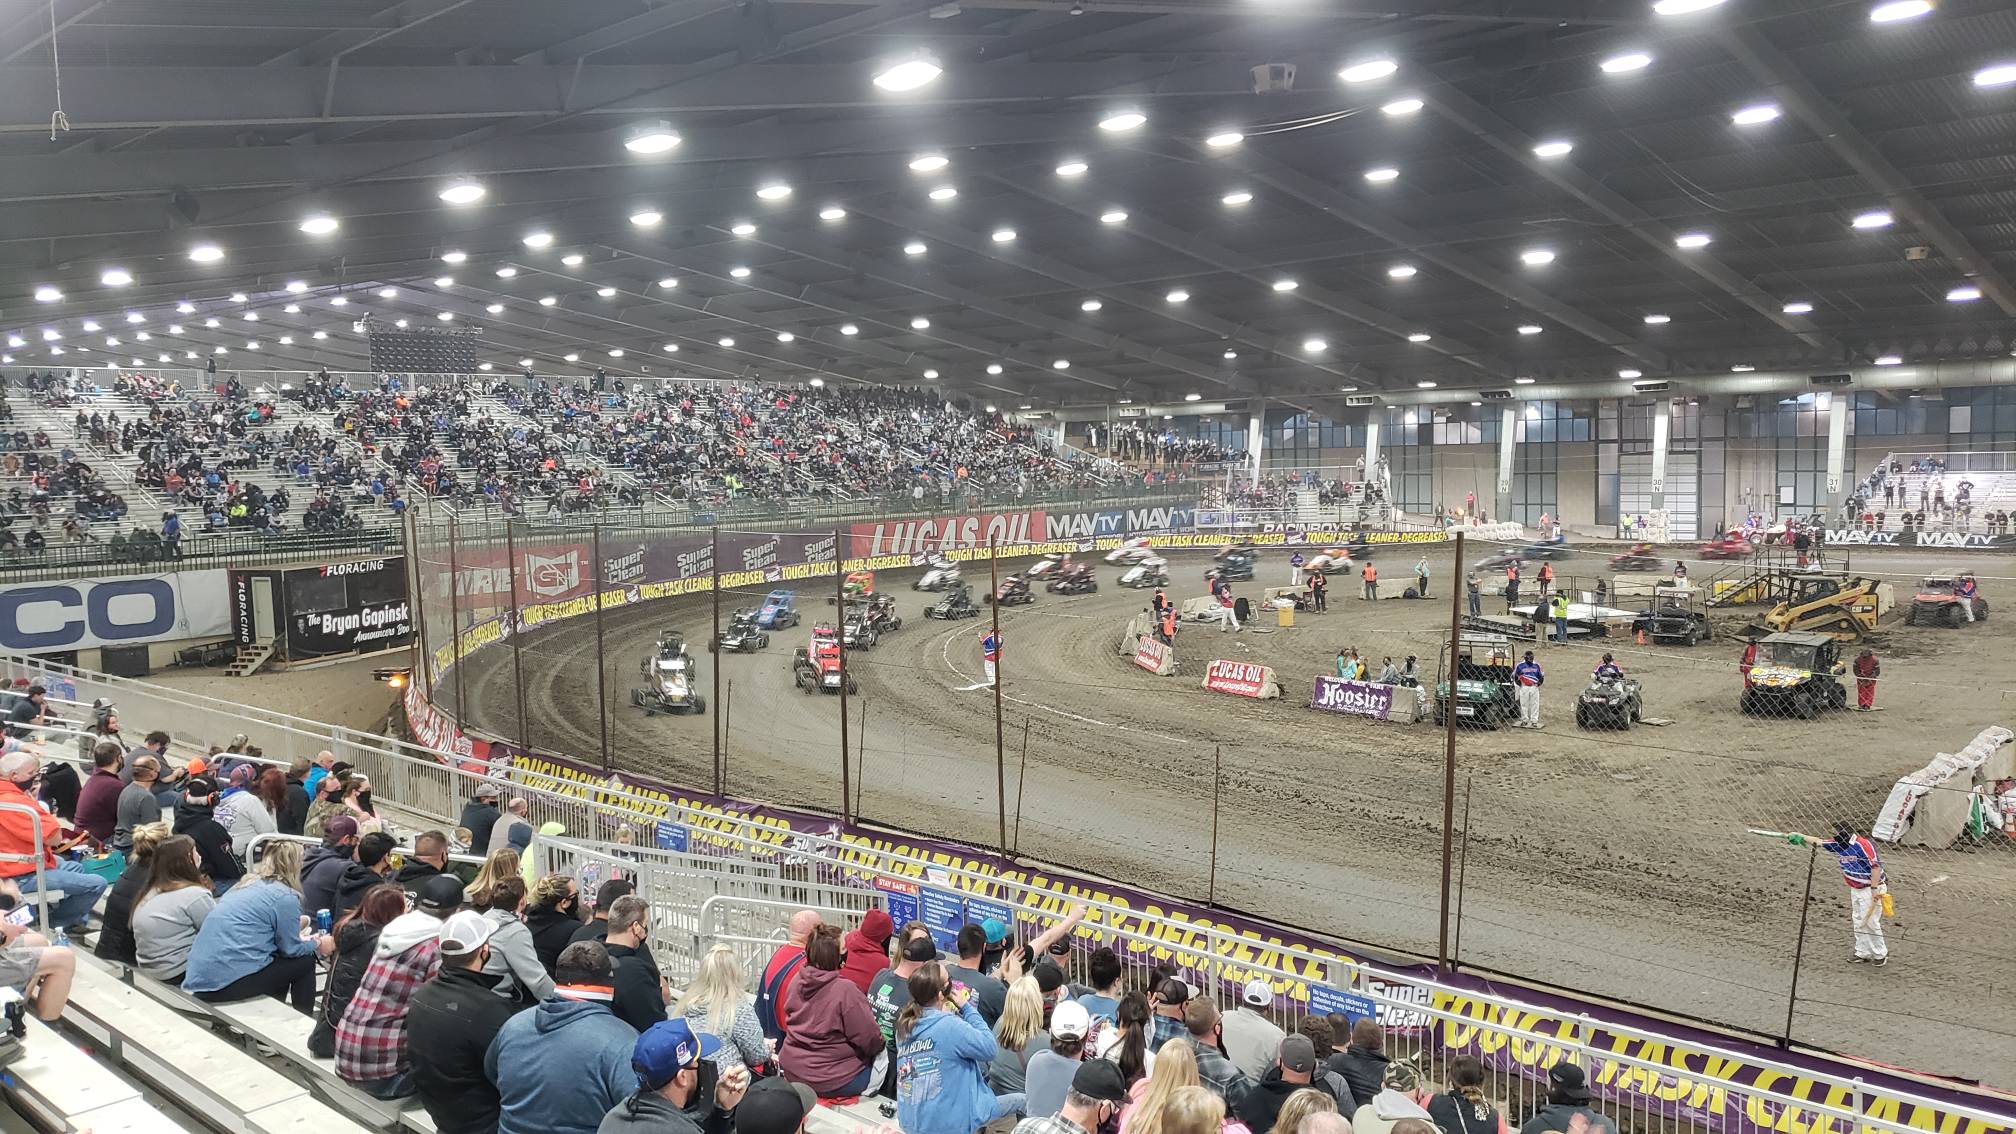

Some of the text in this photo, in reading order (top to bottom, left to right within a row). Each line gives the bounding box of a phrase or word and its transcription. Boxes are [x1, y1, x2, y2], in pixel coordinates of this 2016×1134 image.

[870, 512, 1032, 558] LUCAS OIL
[1096, 538, 1124, 551] TOUGH
[1146, 535, 1171, 548] OUGH
[1171, 534, 1193, 547] TASK
[1306, 531, 1336, 543] TOUGH
[1364, 532, 1449, 544] LEANER-DEGREASER
[742, 540, 776, 562] Super
[804, 536, 836, 556] Super
[807, 549, 836, 563] Clean
[945, 548, 972, 562] TOUGH
[604, 549, 645, 574] Super
[745, 552, 777, 571] Clean
[781, 564, 809, 580] TOUGH
[809, 561, 830, 577] TASK
[830, 554, 911, 575] CEANER-DEGREASER
[608, 563, 645, 585] Clean
[665, 579, 684, 598] TASK
[684, 569, 765, 594] CLEANE-DEGREASER
[558, 587, 626, 619] CLEANER-DEREASER
[307, 602, 408, 636] The Bryan Gapinsk
[353, 623, 410, 644] Announcers Boo
[1211, 662, 1262, 683] LUCAS OIL
[1318, 682, 1388, 711] Hoosier
[879, 878, 906, 892] STAY SAFE
[1313, 996, 1331, 1005] adhesive
[1345, 1004, 1355, 1012] kind
[1346, 997, 1362, 1007] stickers
[1430, 990, 1595, 1070] TOUGH
[1595, 1034, 1747, 1115] TASK
